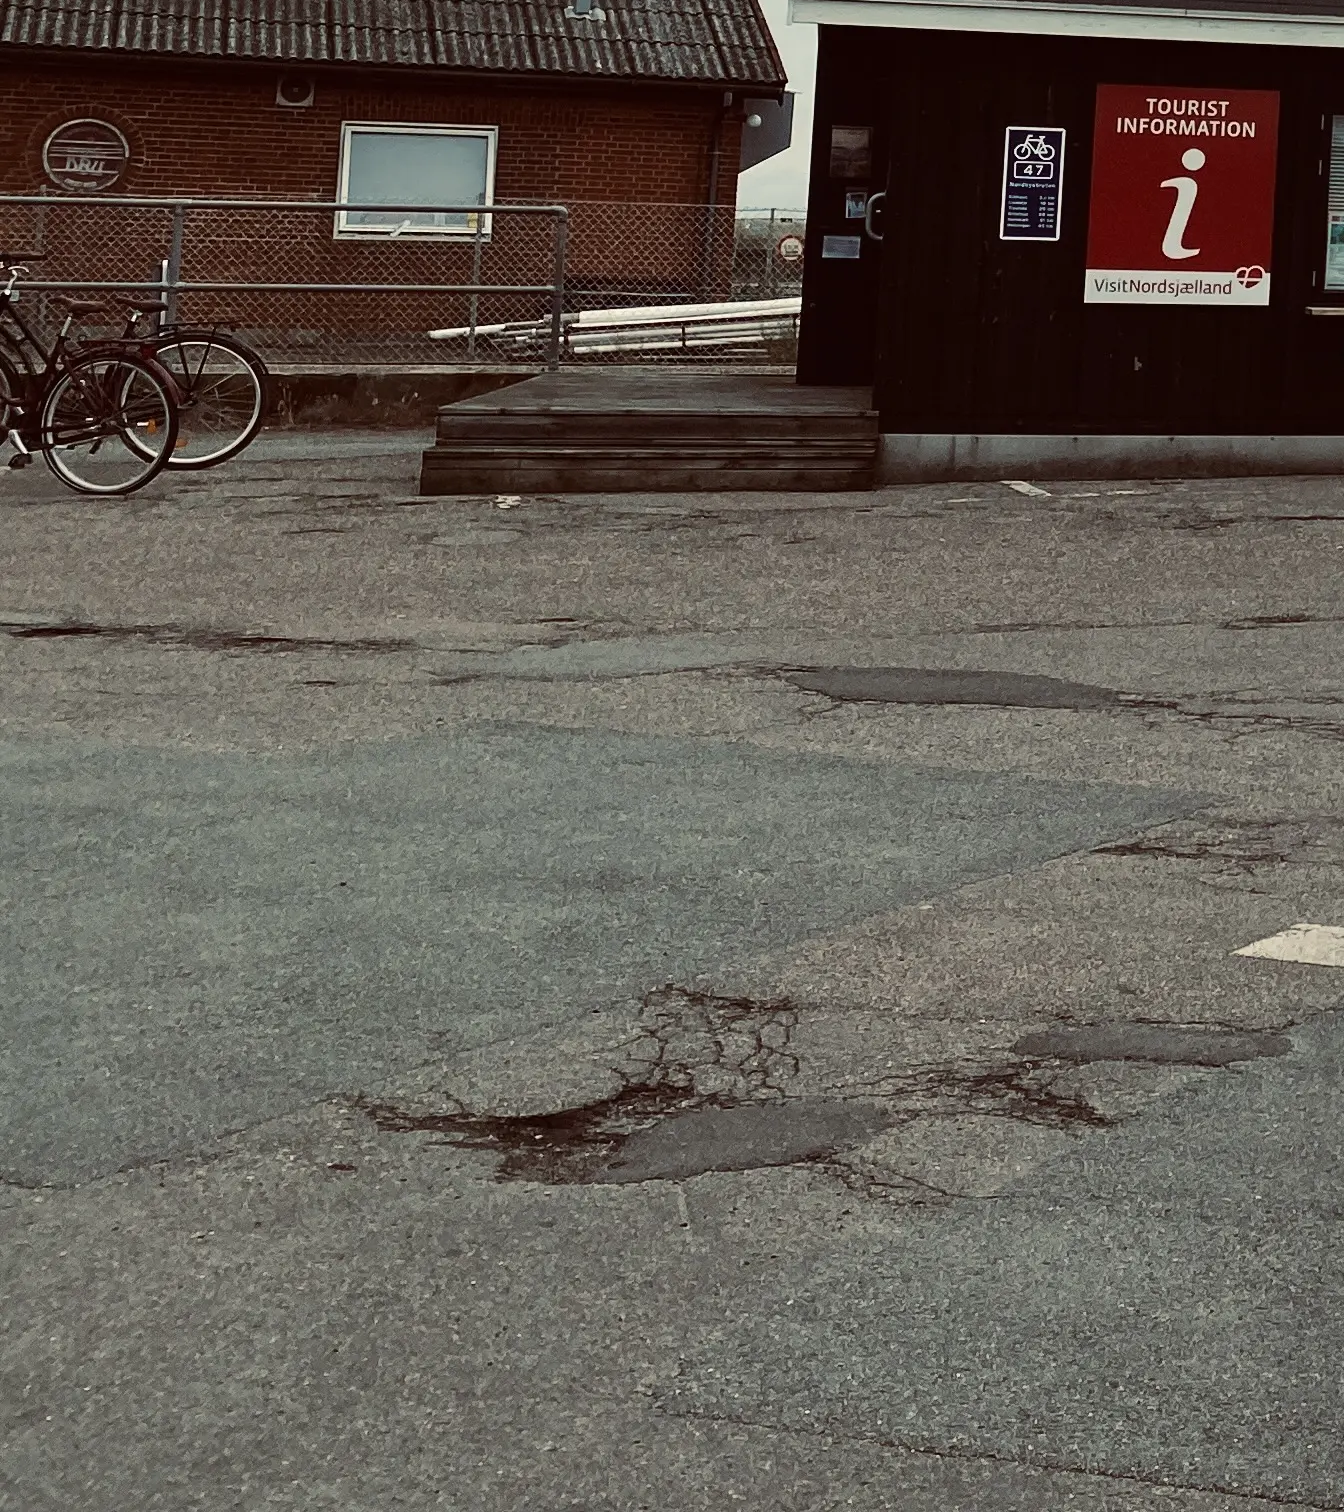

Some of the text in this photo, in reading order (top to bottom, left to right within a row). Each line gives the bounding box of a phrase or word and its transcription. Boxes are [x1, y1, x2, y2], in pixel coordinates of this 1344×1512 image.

[1146, 98, 1229, 117] TOURIST
[1116, 117, 1256, 138] INFORMATION
[1023, 164, 1044, 176] 47
[1094, 278, 1232, 297] VisitNordsjælland
